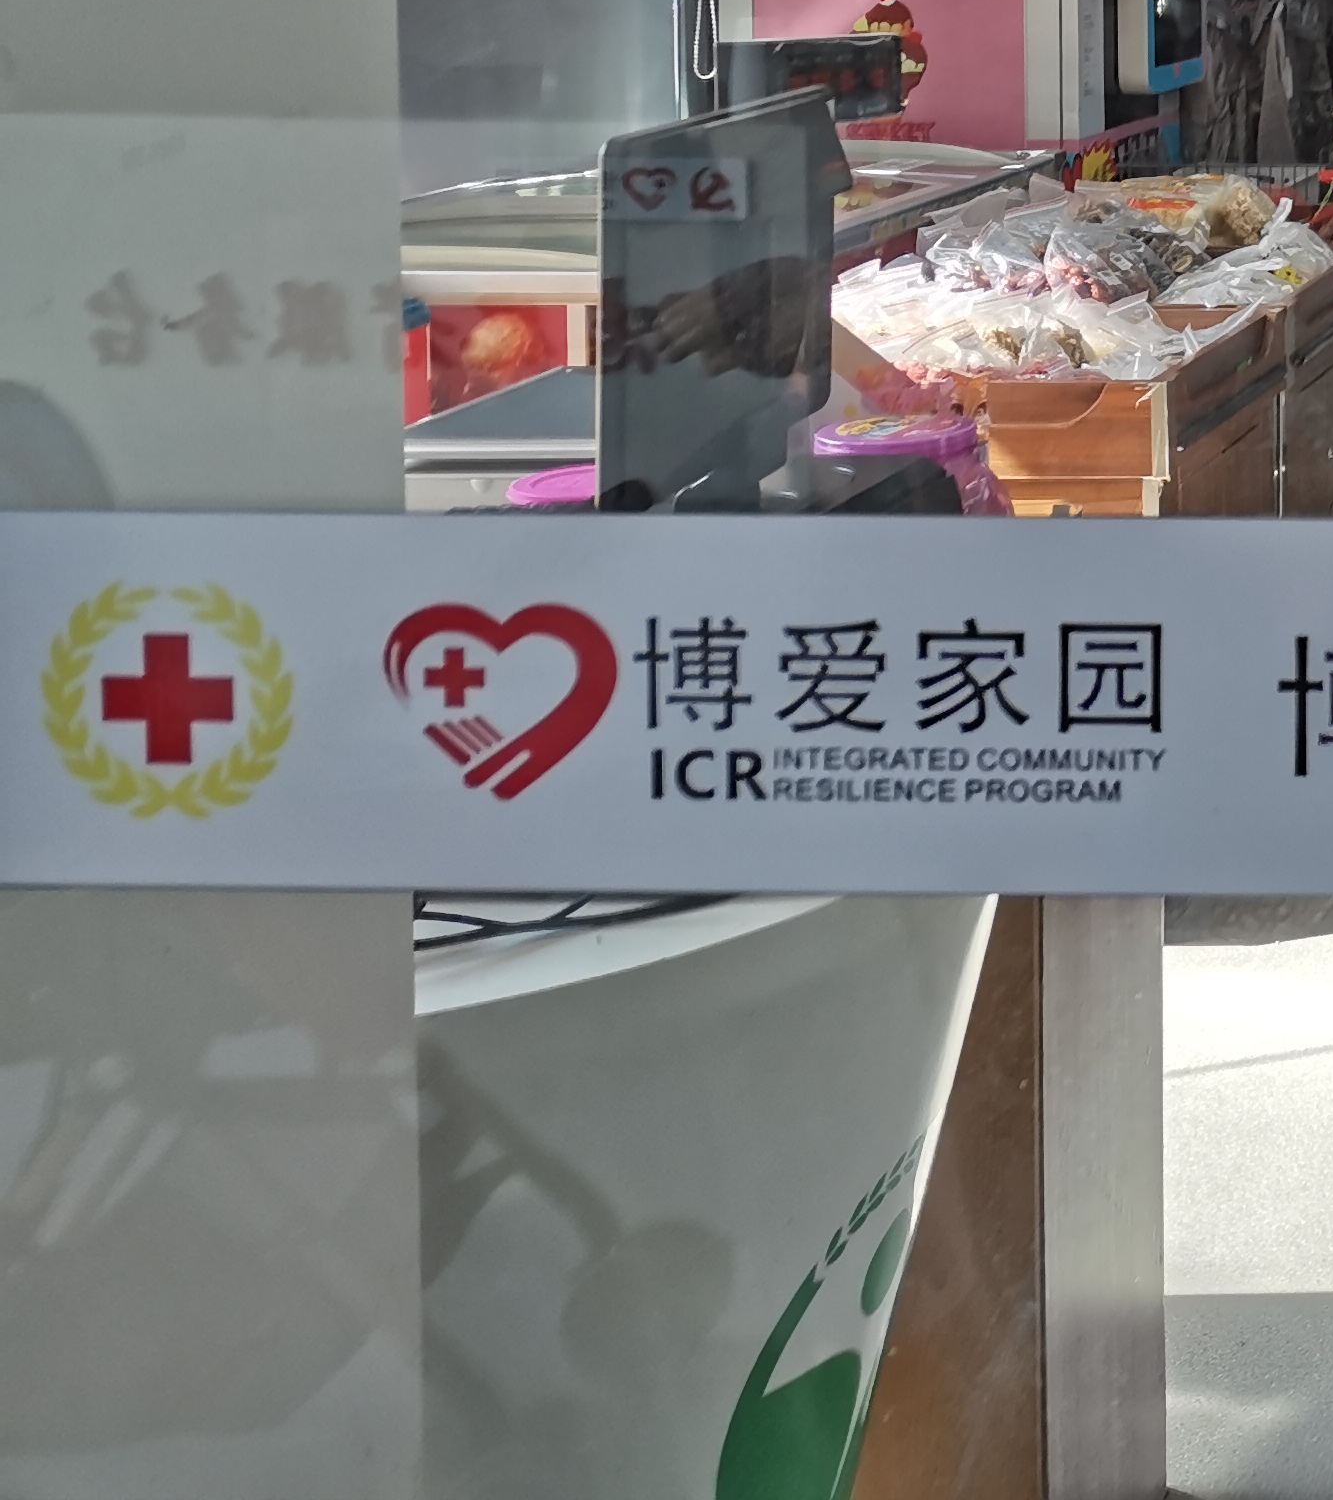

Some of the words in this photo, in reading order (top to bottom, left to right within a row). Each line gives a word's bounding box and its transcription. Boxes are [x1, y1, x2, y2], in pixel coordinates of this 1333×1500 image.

[633, 615, 1163, 733] 博爱家园
[649, 749, 767, 800] ICR
[773, 746, 970, 772] INTEGRATED
[976, 747, 1168, 773] COMMUNITY
[773, 778, 957, 803] RESILIENCE
[964, 778, 1123, 802] PROGRAM
